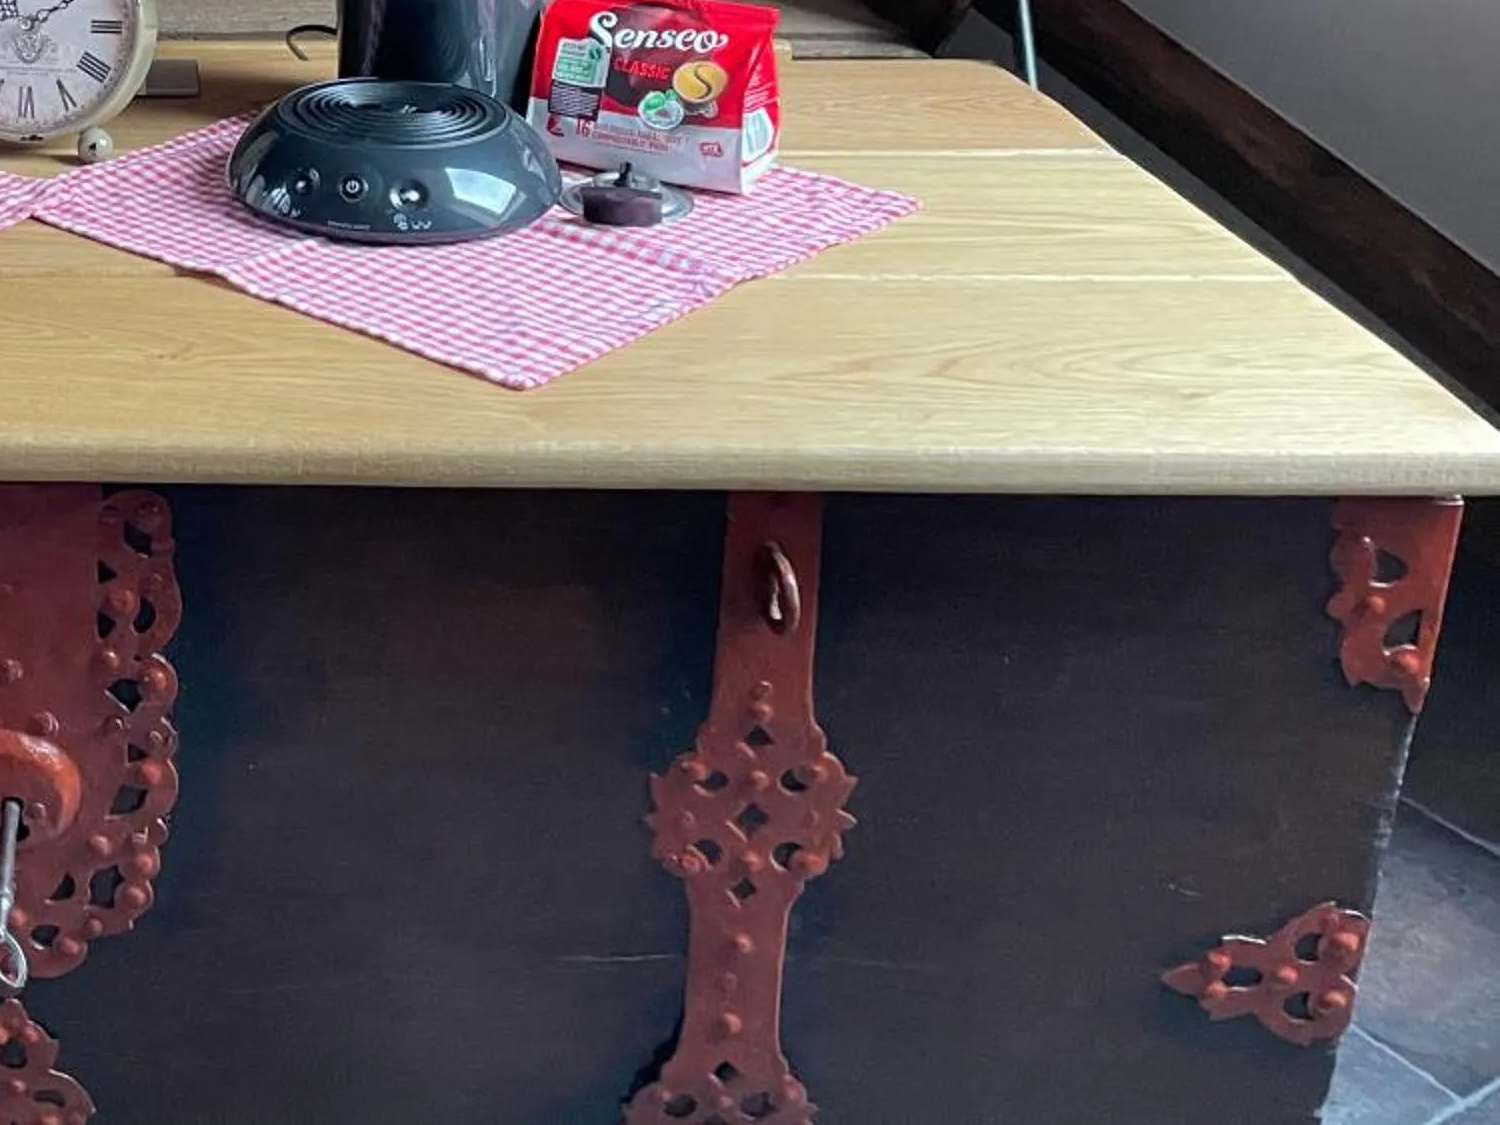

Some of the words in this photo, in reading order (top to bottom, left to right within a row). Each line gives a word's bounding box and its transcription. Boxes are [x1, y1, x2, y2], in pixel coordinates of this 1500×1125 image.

[91, 20, 123, 34] III
[589, 10, 729, 54] Senseo
[613, 57, 671, 81] CLASSIC
[19, 85, 36, 119] VI
[56, 78, 77, 112] V
